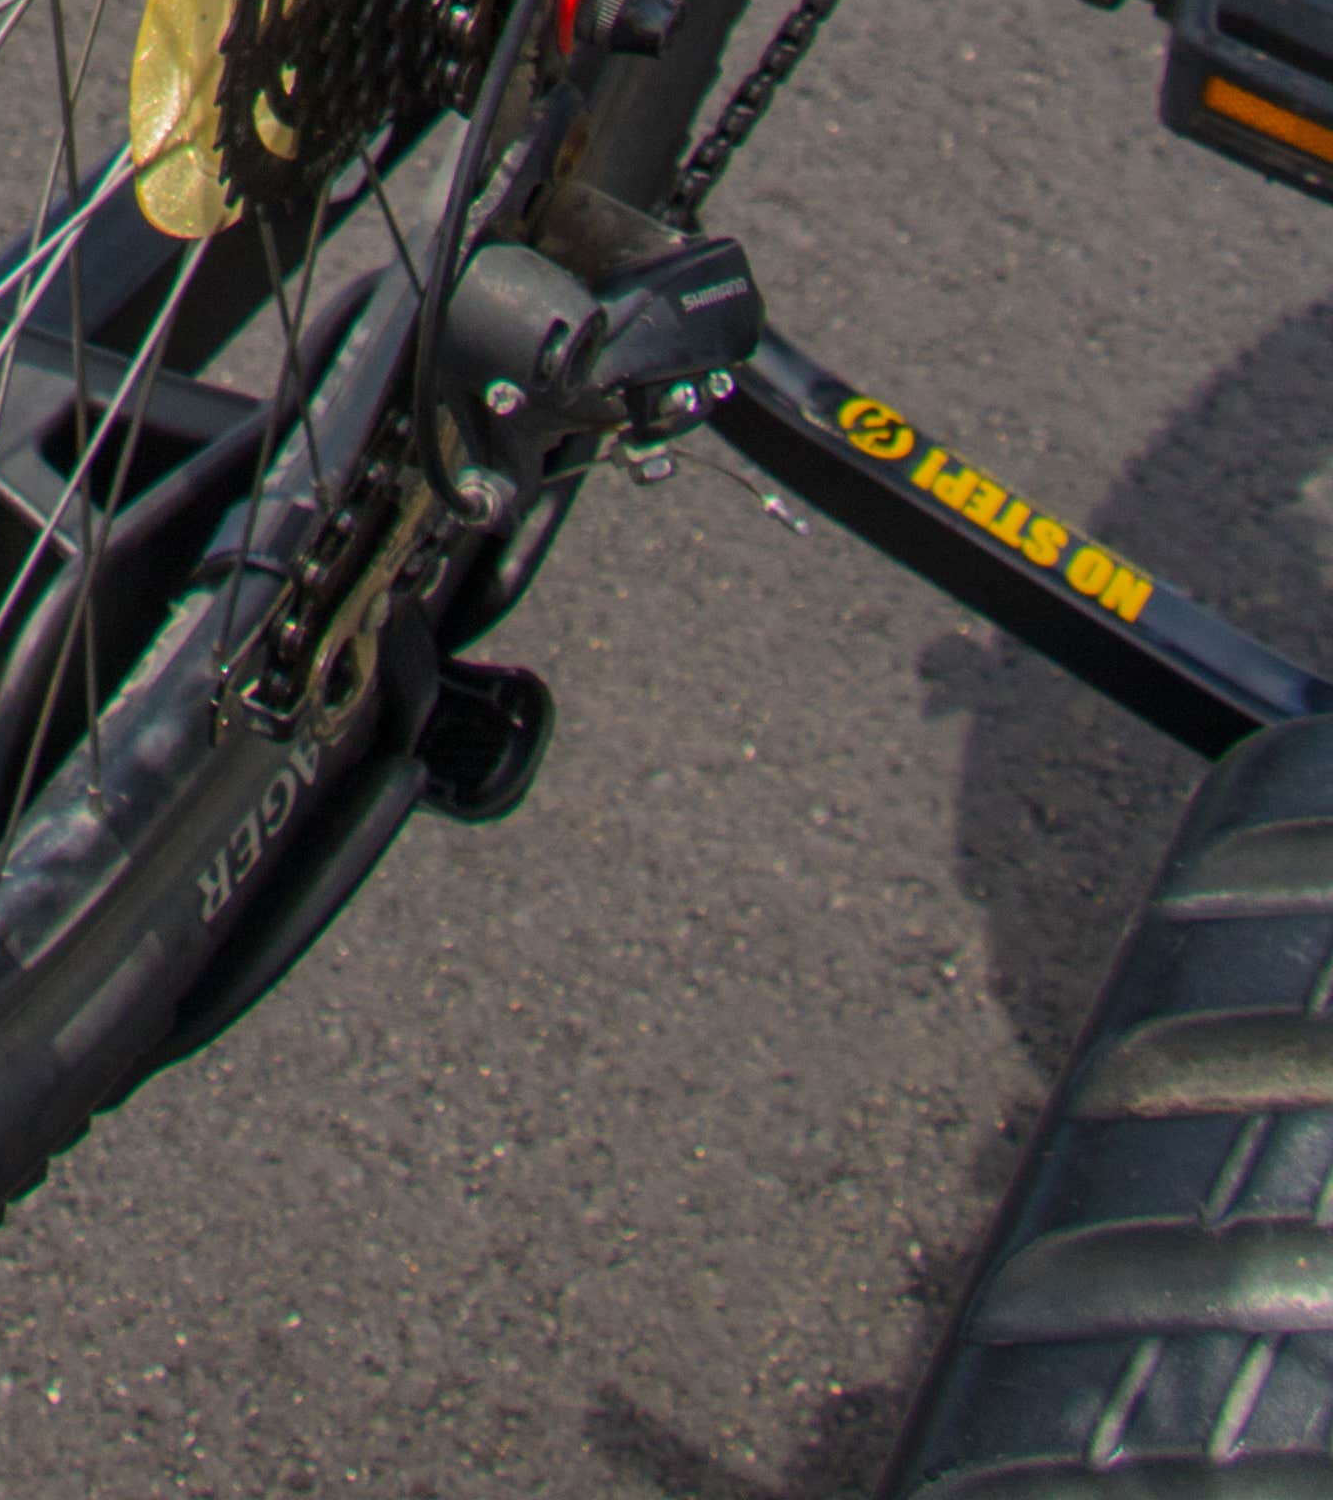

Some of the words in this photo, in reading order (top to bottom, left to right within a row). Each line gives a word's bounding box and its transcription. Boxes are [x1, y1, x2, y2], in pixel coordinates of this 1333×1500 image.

[681, 277, 748, 312] SHIMANO
[911, 447, 1068, 567] STEP!
[1065, 546, 1152, 622] NO
